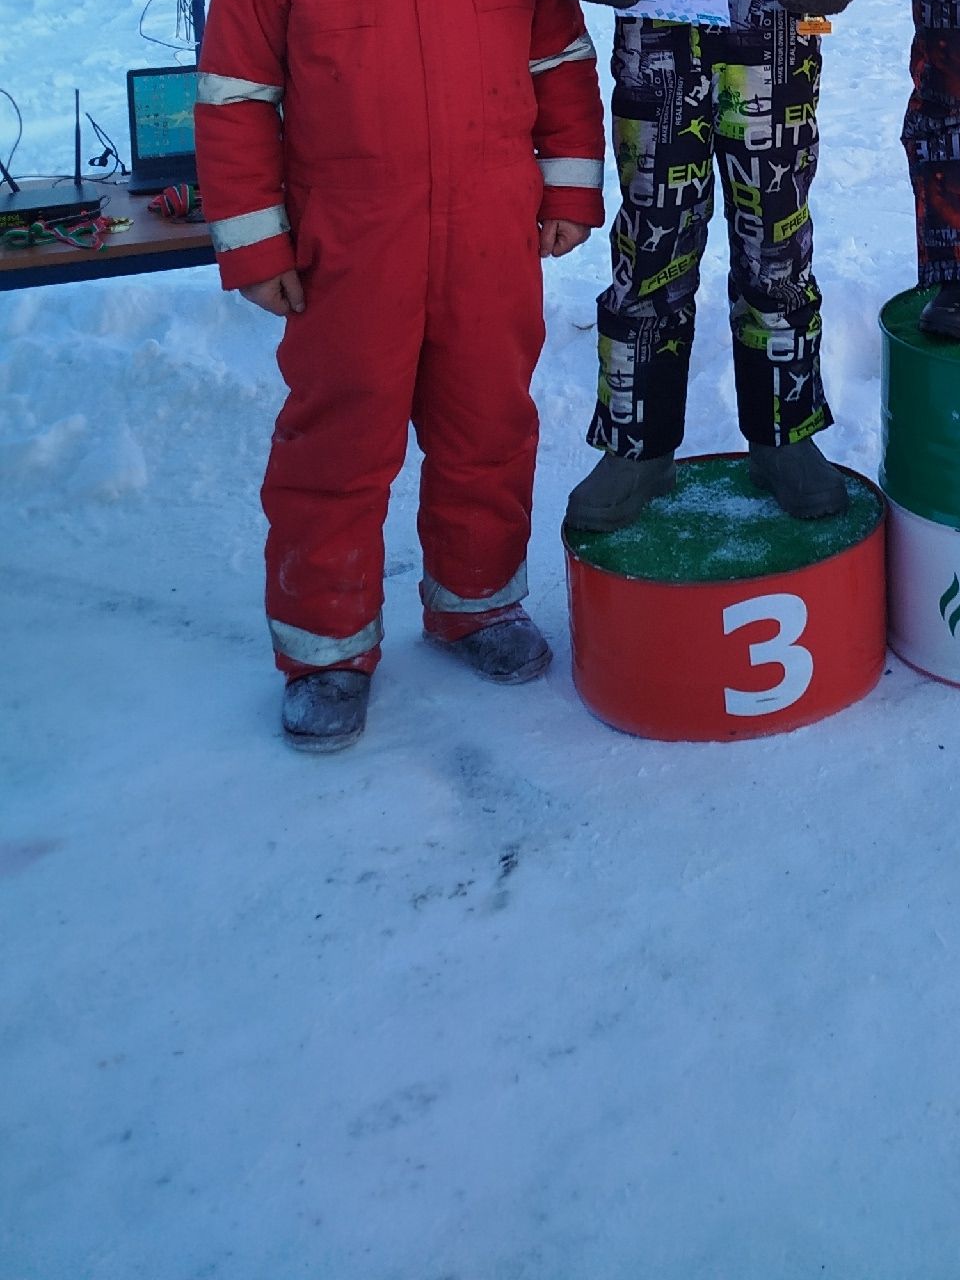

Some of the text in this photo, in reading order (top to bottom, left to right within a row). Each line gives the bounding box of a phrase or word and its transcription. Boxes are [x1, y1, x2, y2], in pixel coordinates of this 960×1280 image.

[789, 16, 797, 66] REAL ENERGY
[676, 76, 684, 106] ENERGY
[721, 592, 815, 717] 3
